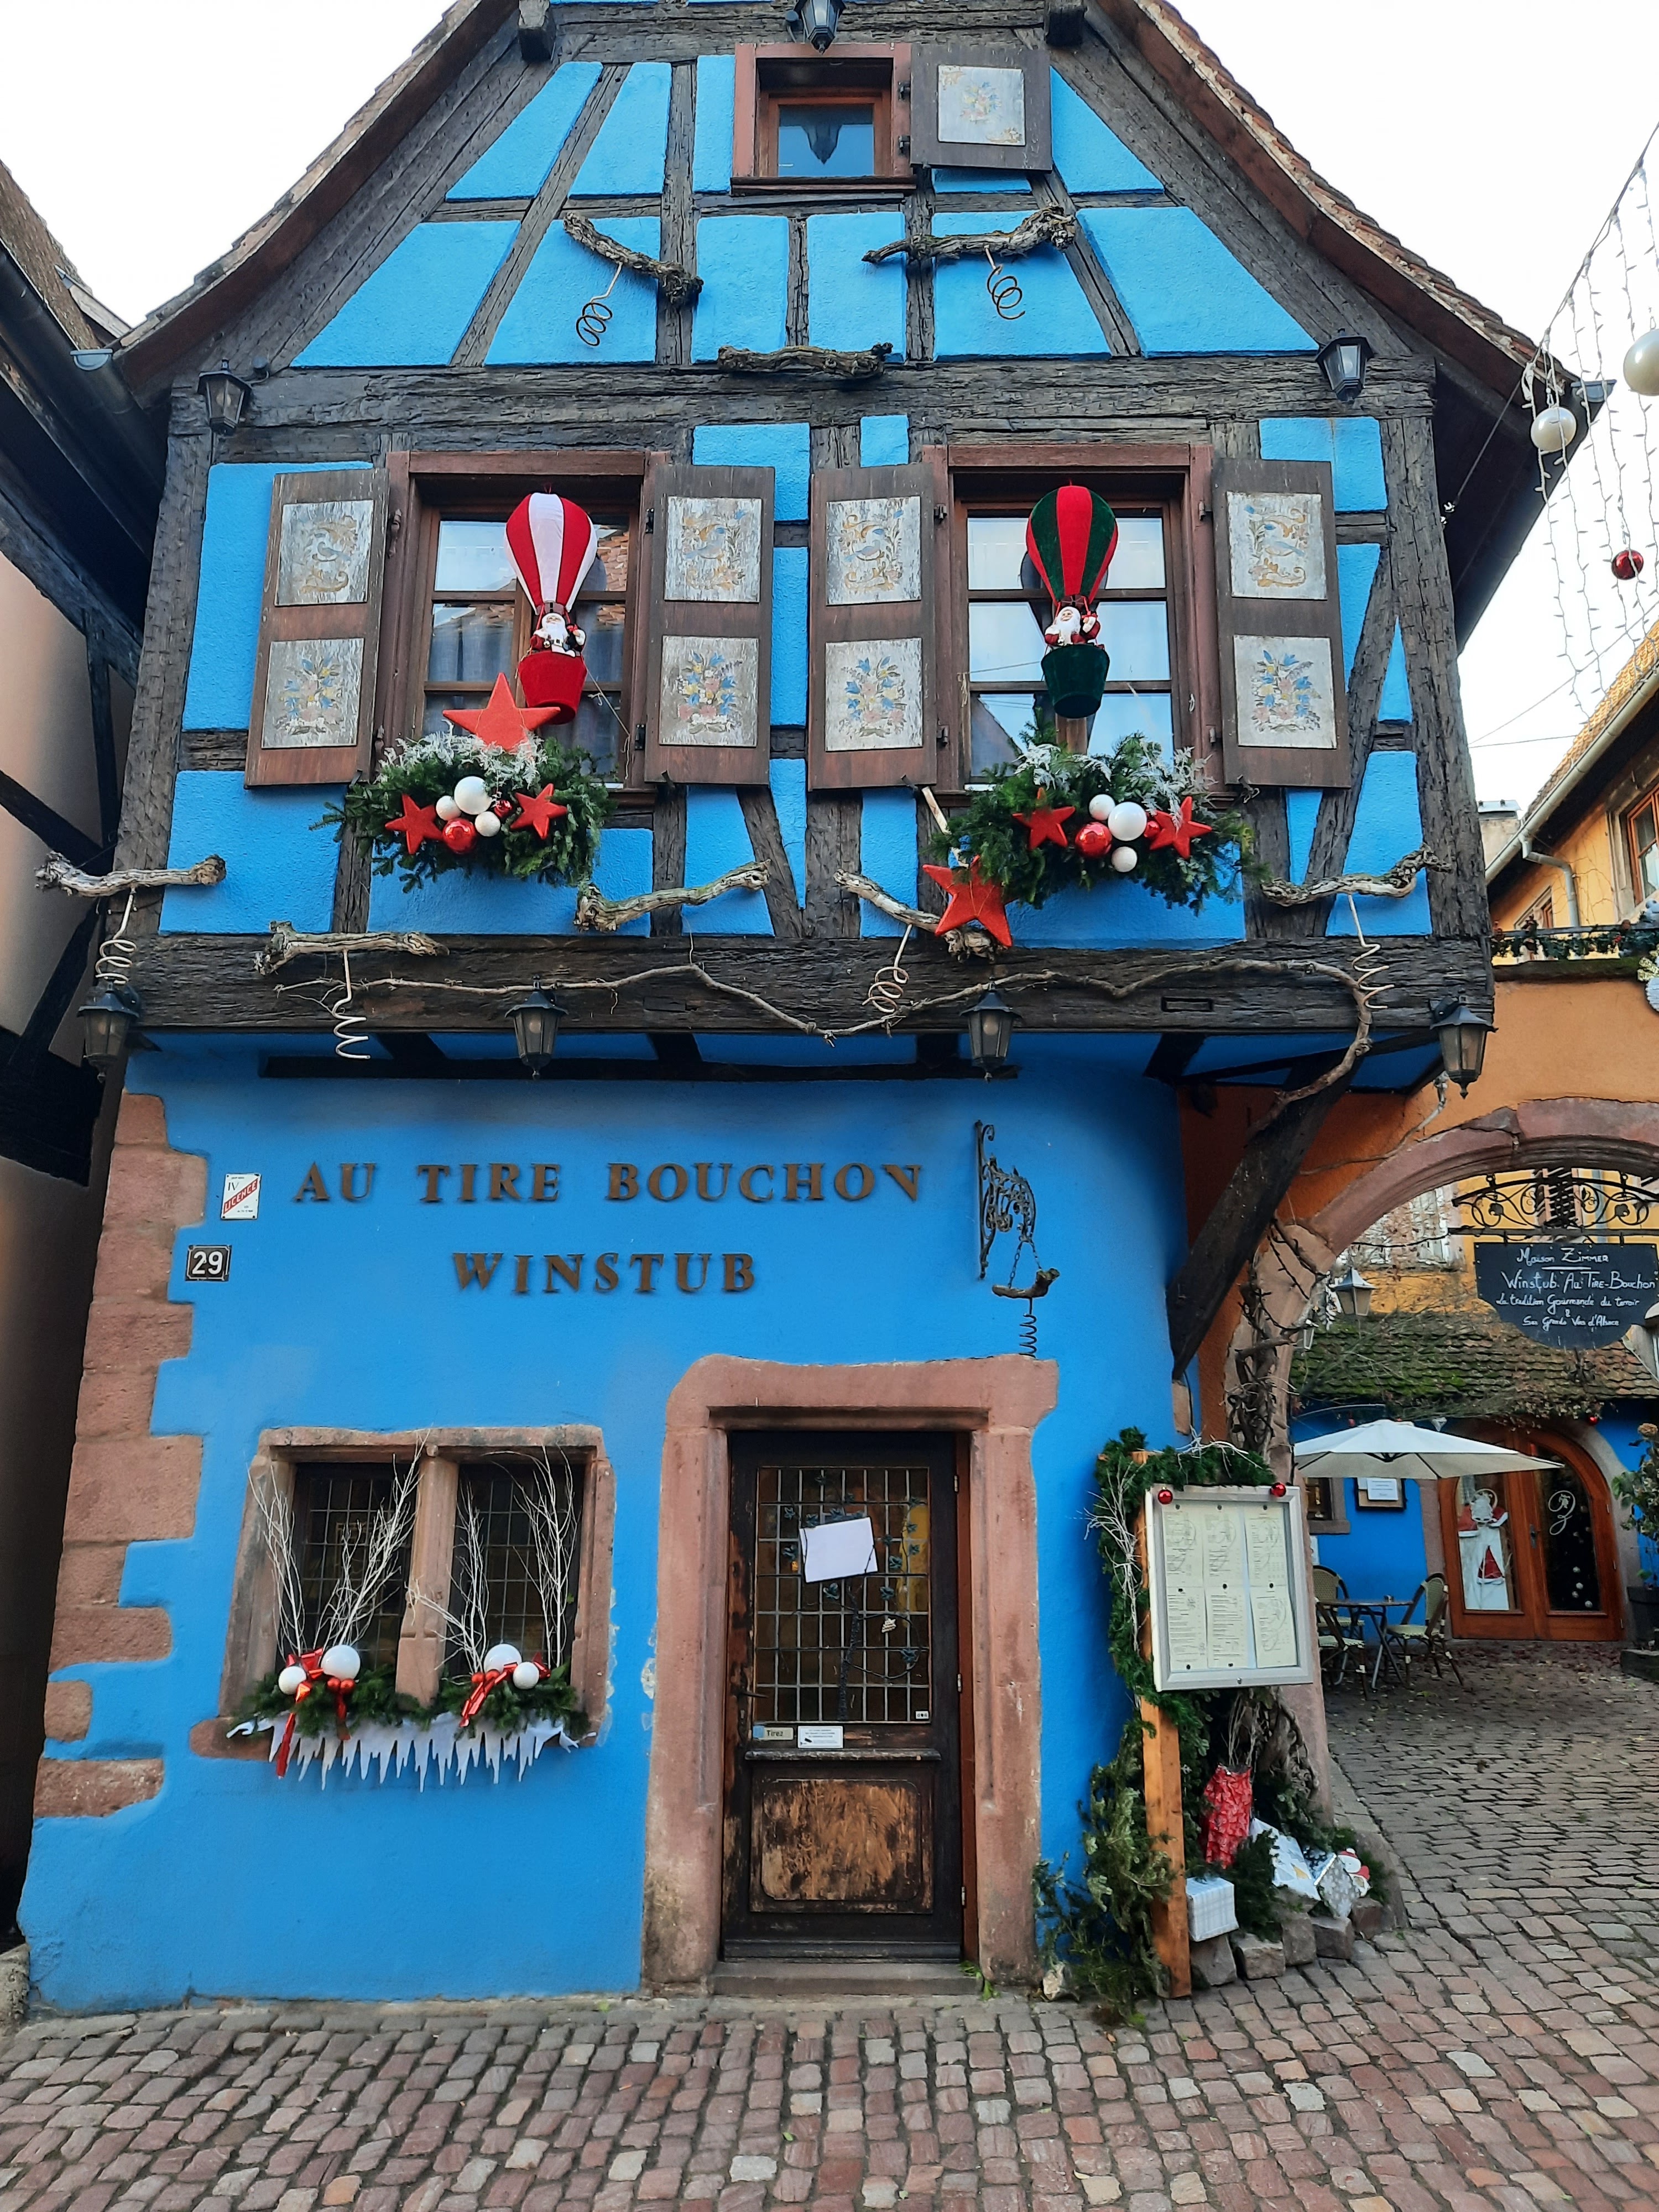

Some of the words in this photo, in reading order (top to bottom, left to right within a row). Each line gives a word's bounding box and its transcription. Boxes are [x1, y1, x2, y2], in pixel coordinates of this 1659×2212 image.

[228, 1182, 239, 1191] IV
[294, 1161, 376, 1202] AU
[417, 1162, 560, 1202] TIRE
[604, 1162, 922, 1202] BOUCHON
[224, 1180, 257, 1212] LICENCE
[192, 1251, 223, 1275] 29
[1516, 1247, 1555, 1266] Maison
[452, 1251, 755, 1293] WINSTUB
[1600, 1296, 1612, 1306] du
